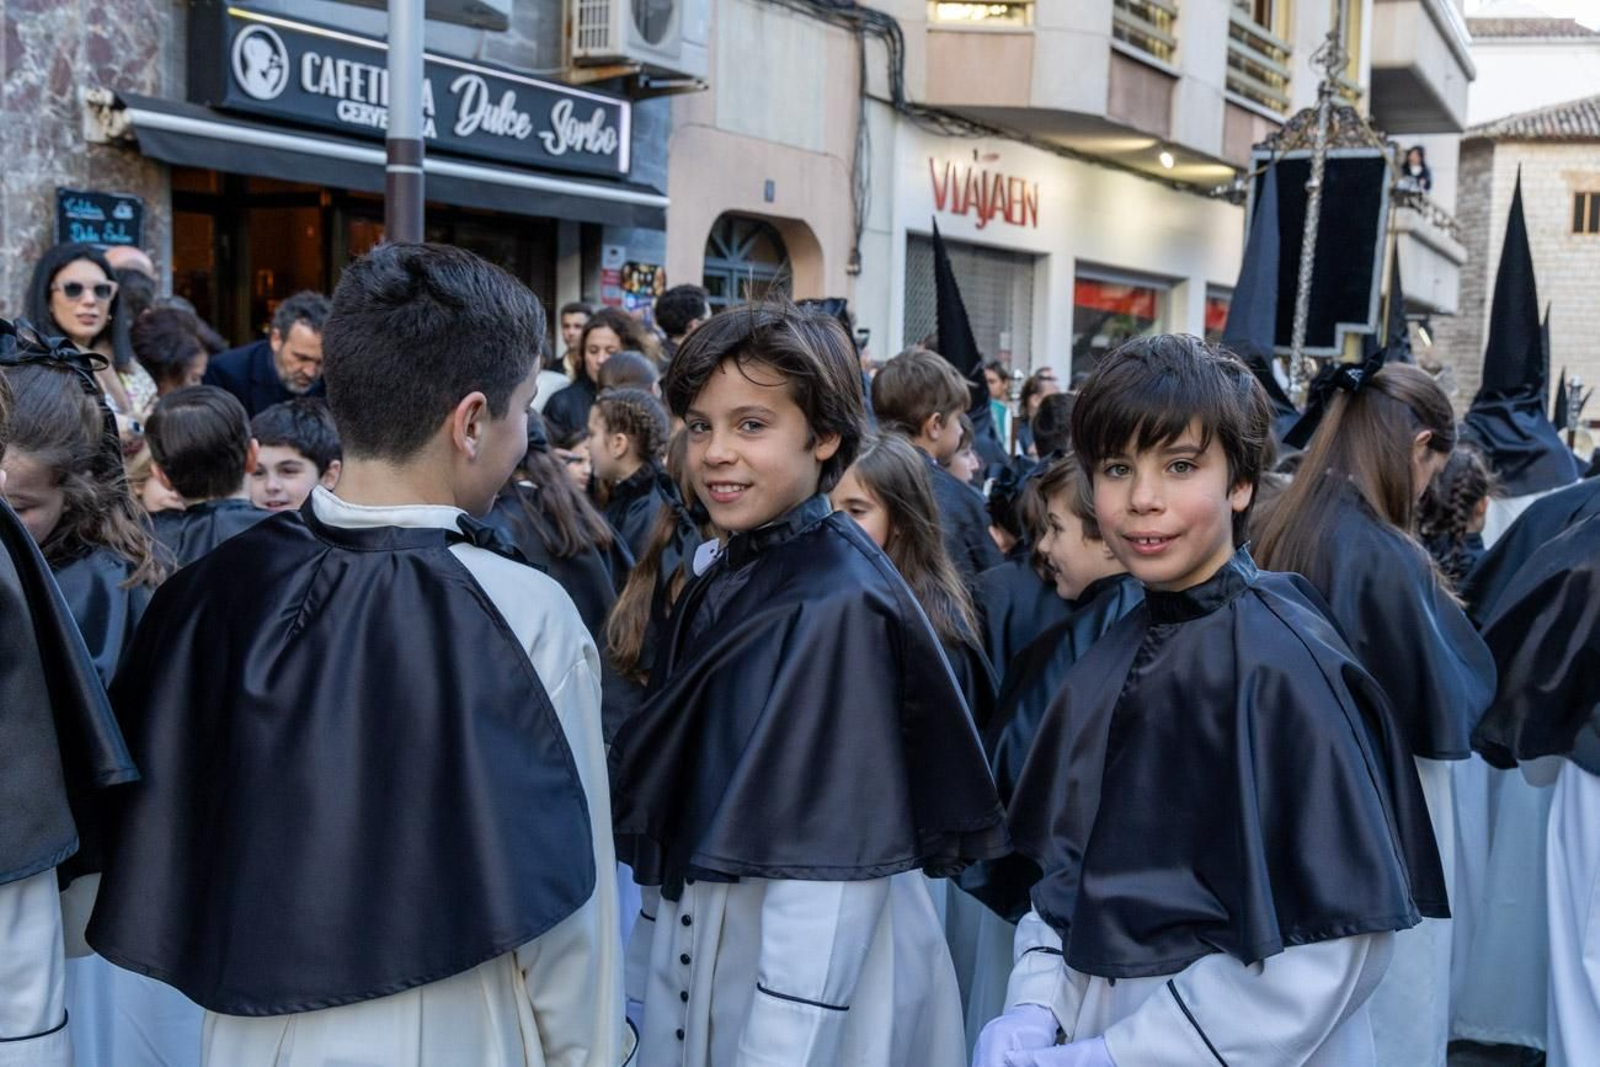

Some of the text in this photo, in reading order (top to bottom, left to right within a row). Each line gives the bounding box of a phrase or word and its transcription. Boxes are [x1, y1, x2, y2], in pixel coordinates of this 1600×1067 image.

[301, 52, 435, 117] CAFETA
[450, 74, 618, 155] Dulce Sorbo
